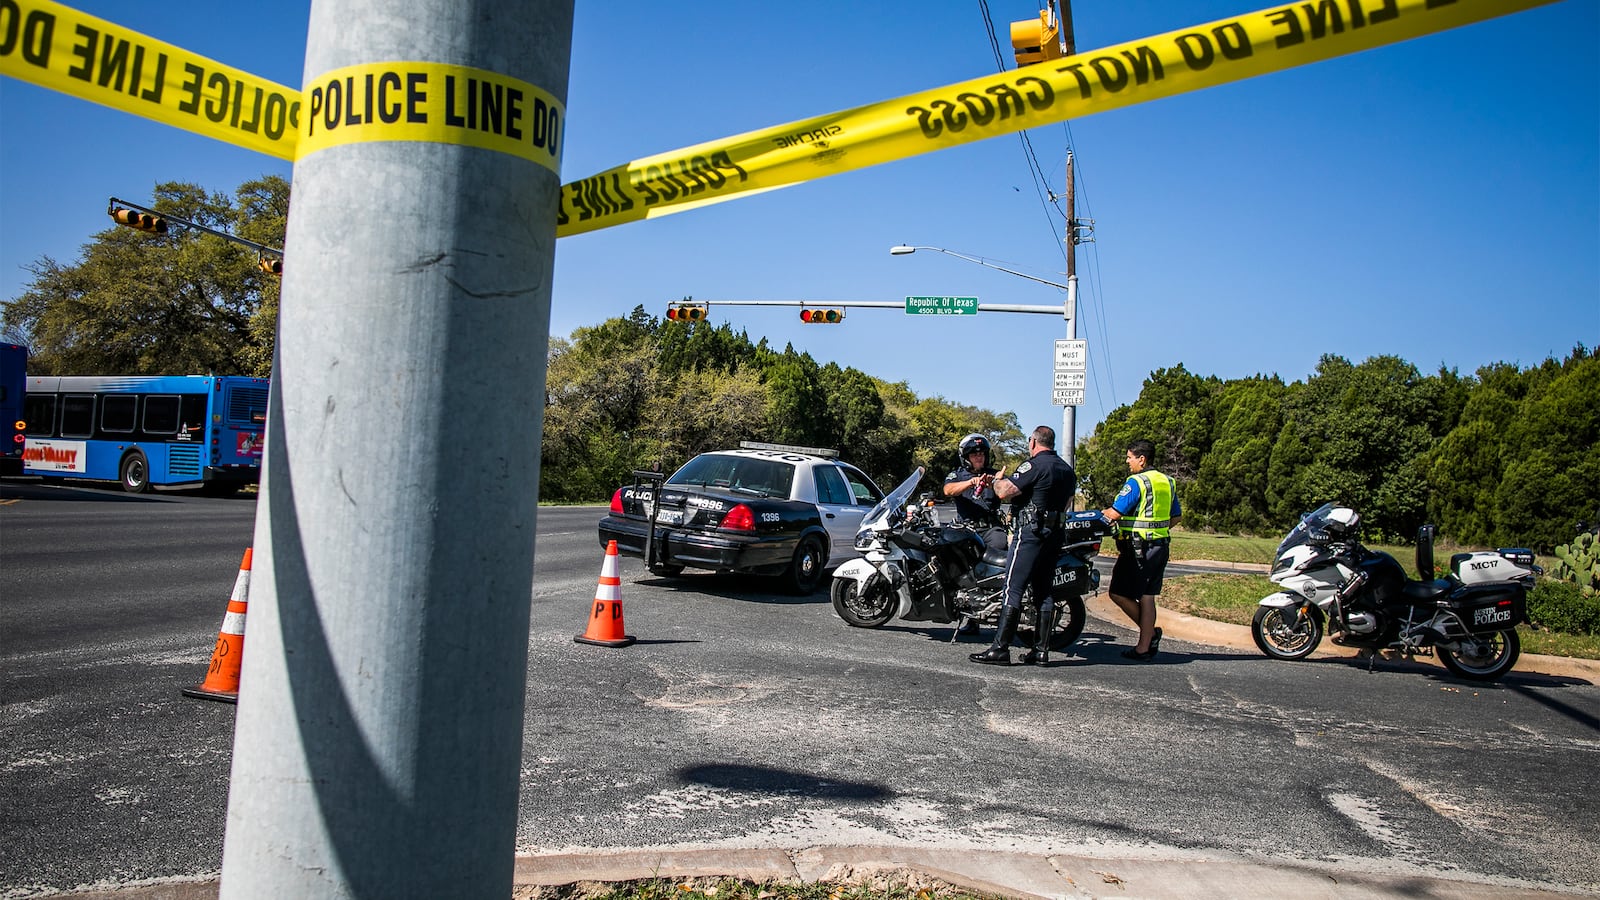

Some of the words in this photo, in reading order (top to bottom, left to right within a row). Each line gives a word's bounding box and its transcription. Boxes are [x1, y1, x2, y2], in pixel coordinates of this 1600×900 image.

[309, 72, 428, 137] POLICE
[445, 75, 523, 140] LINE
[533, 97, 559, 156] DO
[909, 297, 939, 307] Republic
[942, 297, 950, 307] Of
[953, 297, 974, 307] Texas
[43, 446, 77, 463] VALLEY
[761, 513, 780, 522] 1396
[1065, 520, 1091, 530] MC16
[1470, 560, 1499, 570] MC17
[1474, 606, 1496, 616] AUSTIN
[1474, 610, 1511, 625] POLICE
